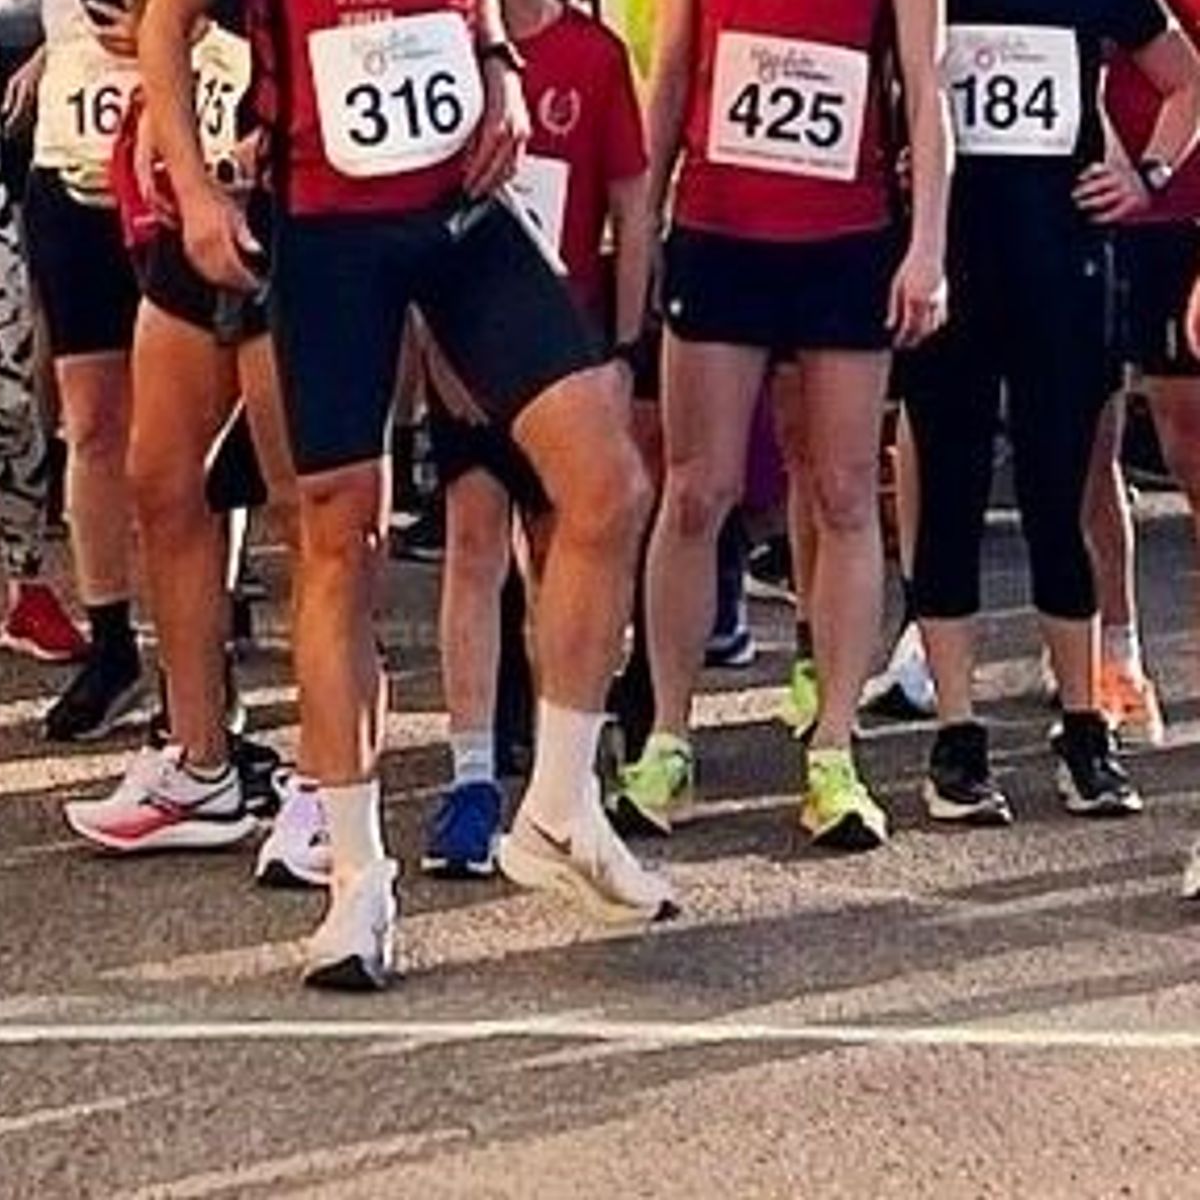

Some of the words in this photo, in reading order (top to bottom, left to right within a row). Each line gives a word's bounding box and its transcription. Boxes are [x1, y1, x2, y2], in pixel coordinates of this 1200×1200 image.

[345, 71, 464, 146] 316
[728, 82, 844, 149] 425
[951, 74, 1060, 131] 184
